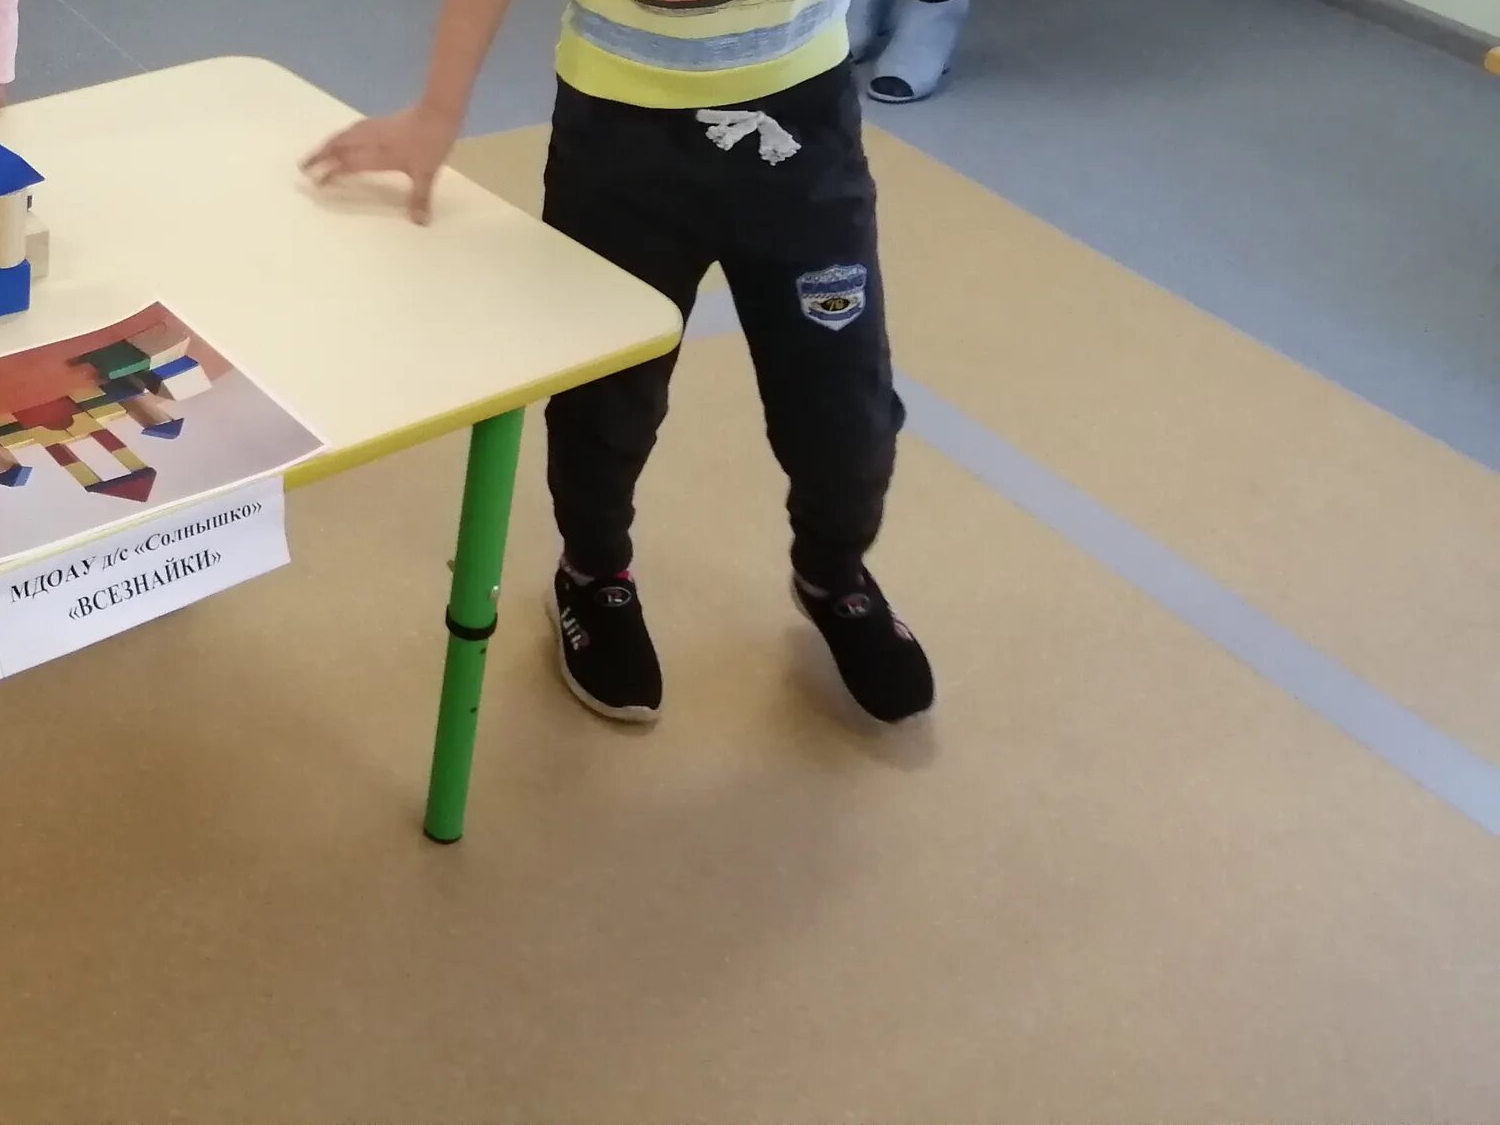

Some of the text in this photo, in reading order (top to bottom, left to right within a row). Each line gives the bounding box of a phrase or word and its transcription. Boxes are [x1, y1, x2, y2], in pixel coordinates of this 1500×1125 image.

[10, 500, 263, 603] МДОАУ д/с «Солнышко»
[68, 549, 222, 621] «ВСЕЗНАЙКИ»
